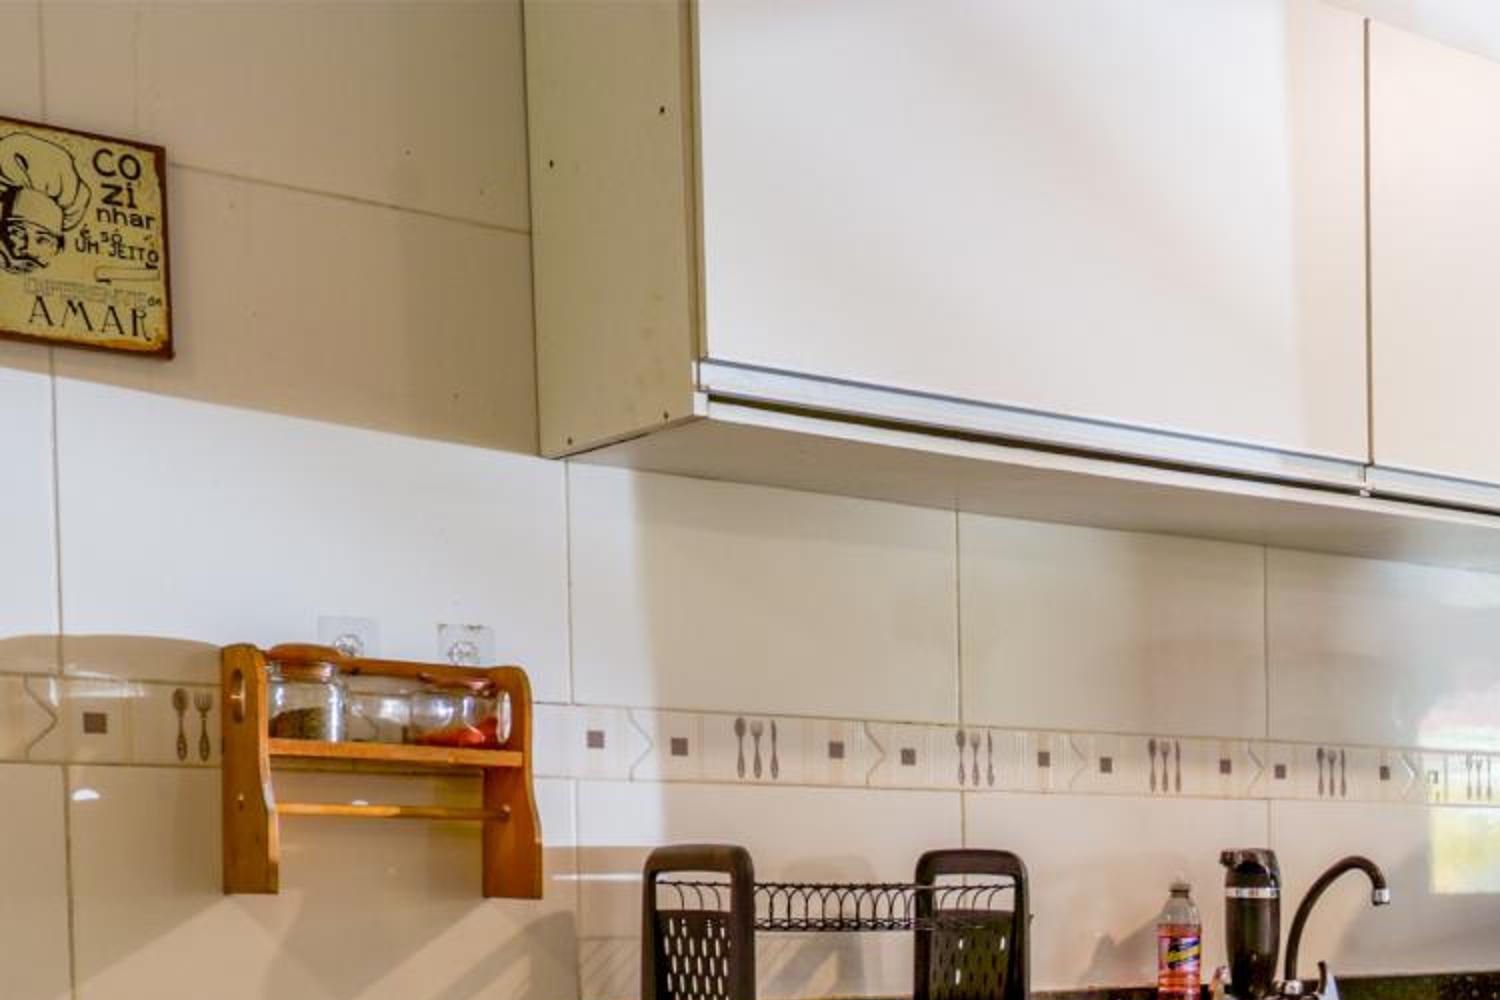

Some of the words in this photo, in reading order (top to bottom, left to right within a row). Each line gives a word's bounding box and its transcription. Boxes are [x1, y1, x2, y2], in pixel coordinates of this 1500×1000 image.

[92, 148, 141, 181] CO
[96, 207, 155, 230] nhar
[28, 295, 152, 341] AMAR
